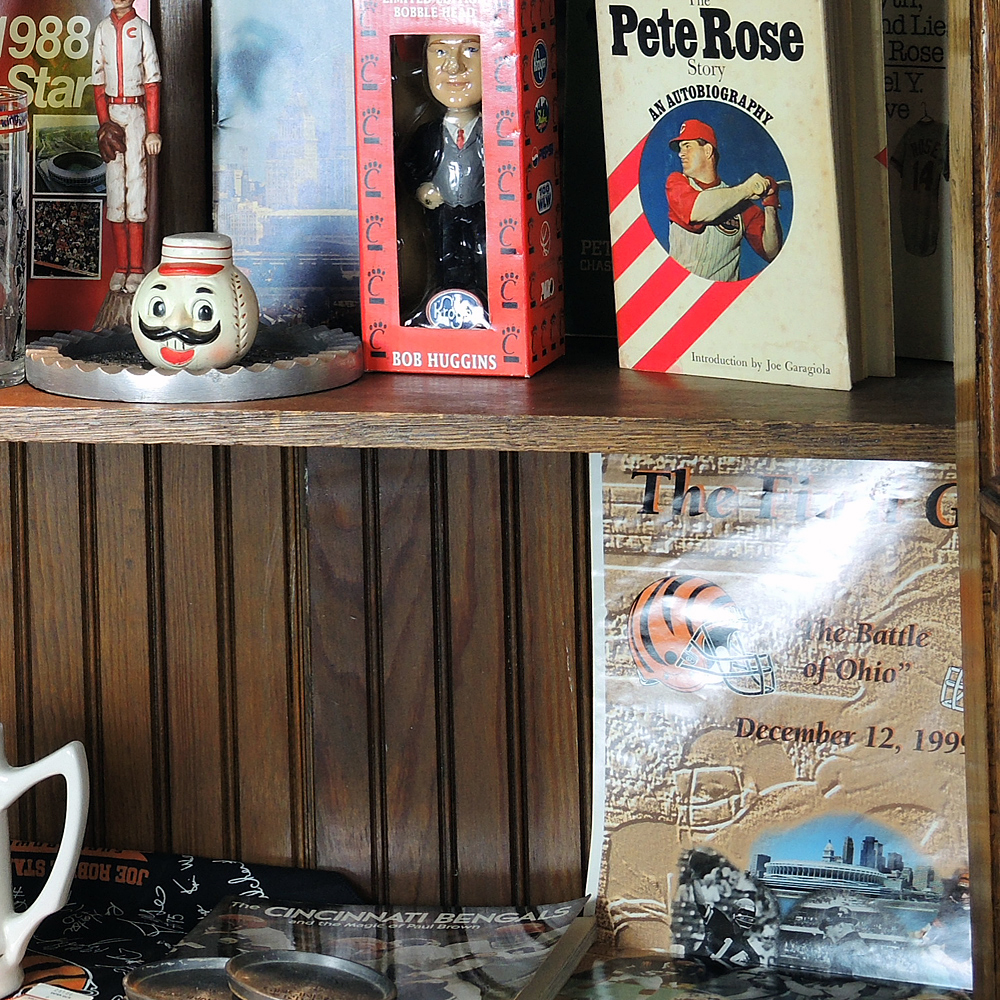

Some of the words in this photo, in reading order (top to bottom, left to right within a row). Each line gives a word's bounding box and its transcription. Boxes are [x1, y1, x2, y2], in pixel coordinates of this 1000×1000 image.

[393, 6, 438, 18] BOBBLE
[608, 4, 697, 58] Pete
[699, 7, 805, 62] Rose
[888, 39, 944, 63] Rose
[687, 58, 726, 82] Story
[904, 72, 924, 93] Y.
[647, 103, 666, 122] AN
[666, 83, 774, 126] AUTOBIOGRAPHY
[392, 351, 423, 367] BOB
[427, 352, 498, 370] HUGGINS
[691, 351, 748, 368] Introduction
[751, 357, 763, 372] by
[765, 358, 782, 373] Joe
[784, 360, 832, 377] Garagiola
[631, 466, 737, 520] The
[855, 622, 931, 648] Battle
[802, 655, 834, 687] of
[836, 657, 912, 684] Ohio”
[736, 715, 854, 747] December
[865, 724, 902, 754] 12,
[116, 864, 150, 886] JOE
[231, 900, 261, 910] The
[264, 904, 429, 924] CINCINNATI
[434, 904, 571, 925] BENGALS
[348, 921, 385, 931] Magic
[406, 923, 434, 931] Paul
[436, 923, 481, 932] Brown
